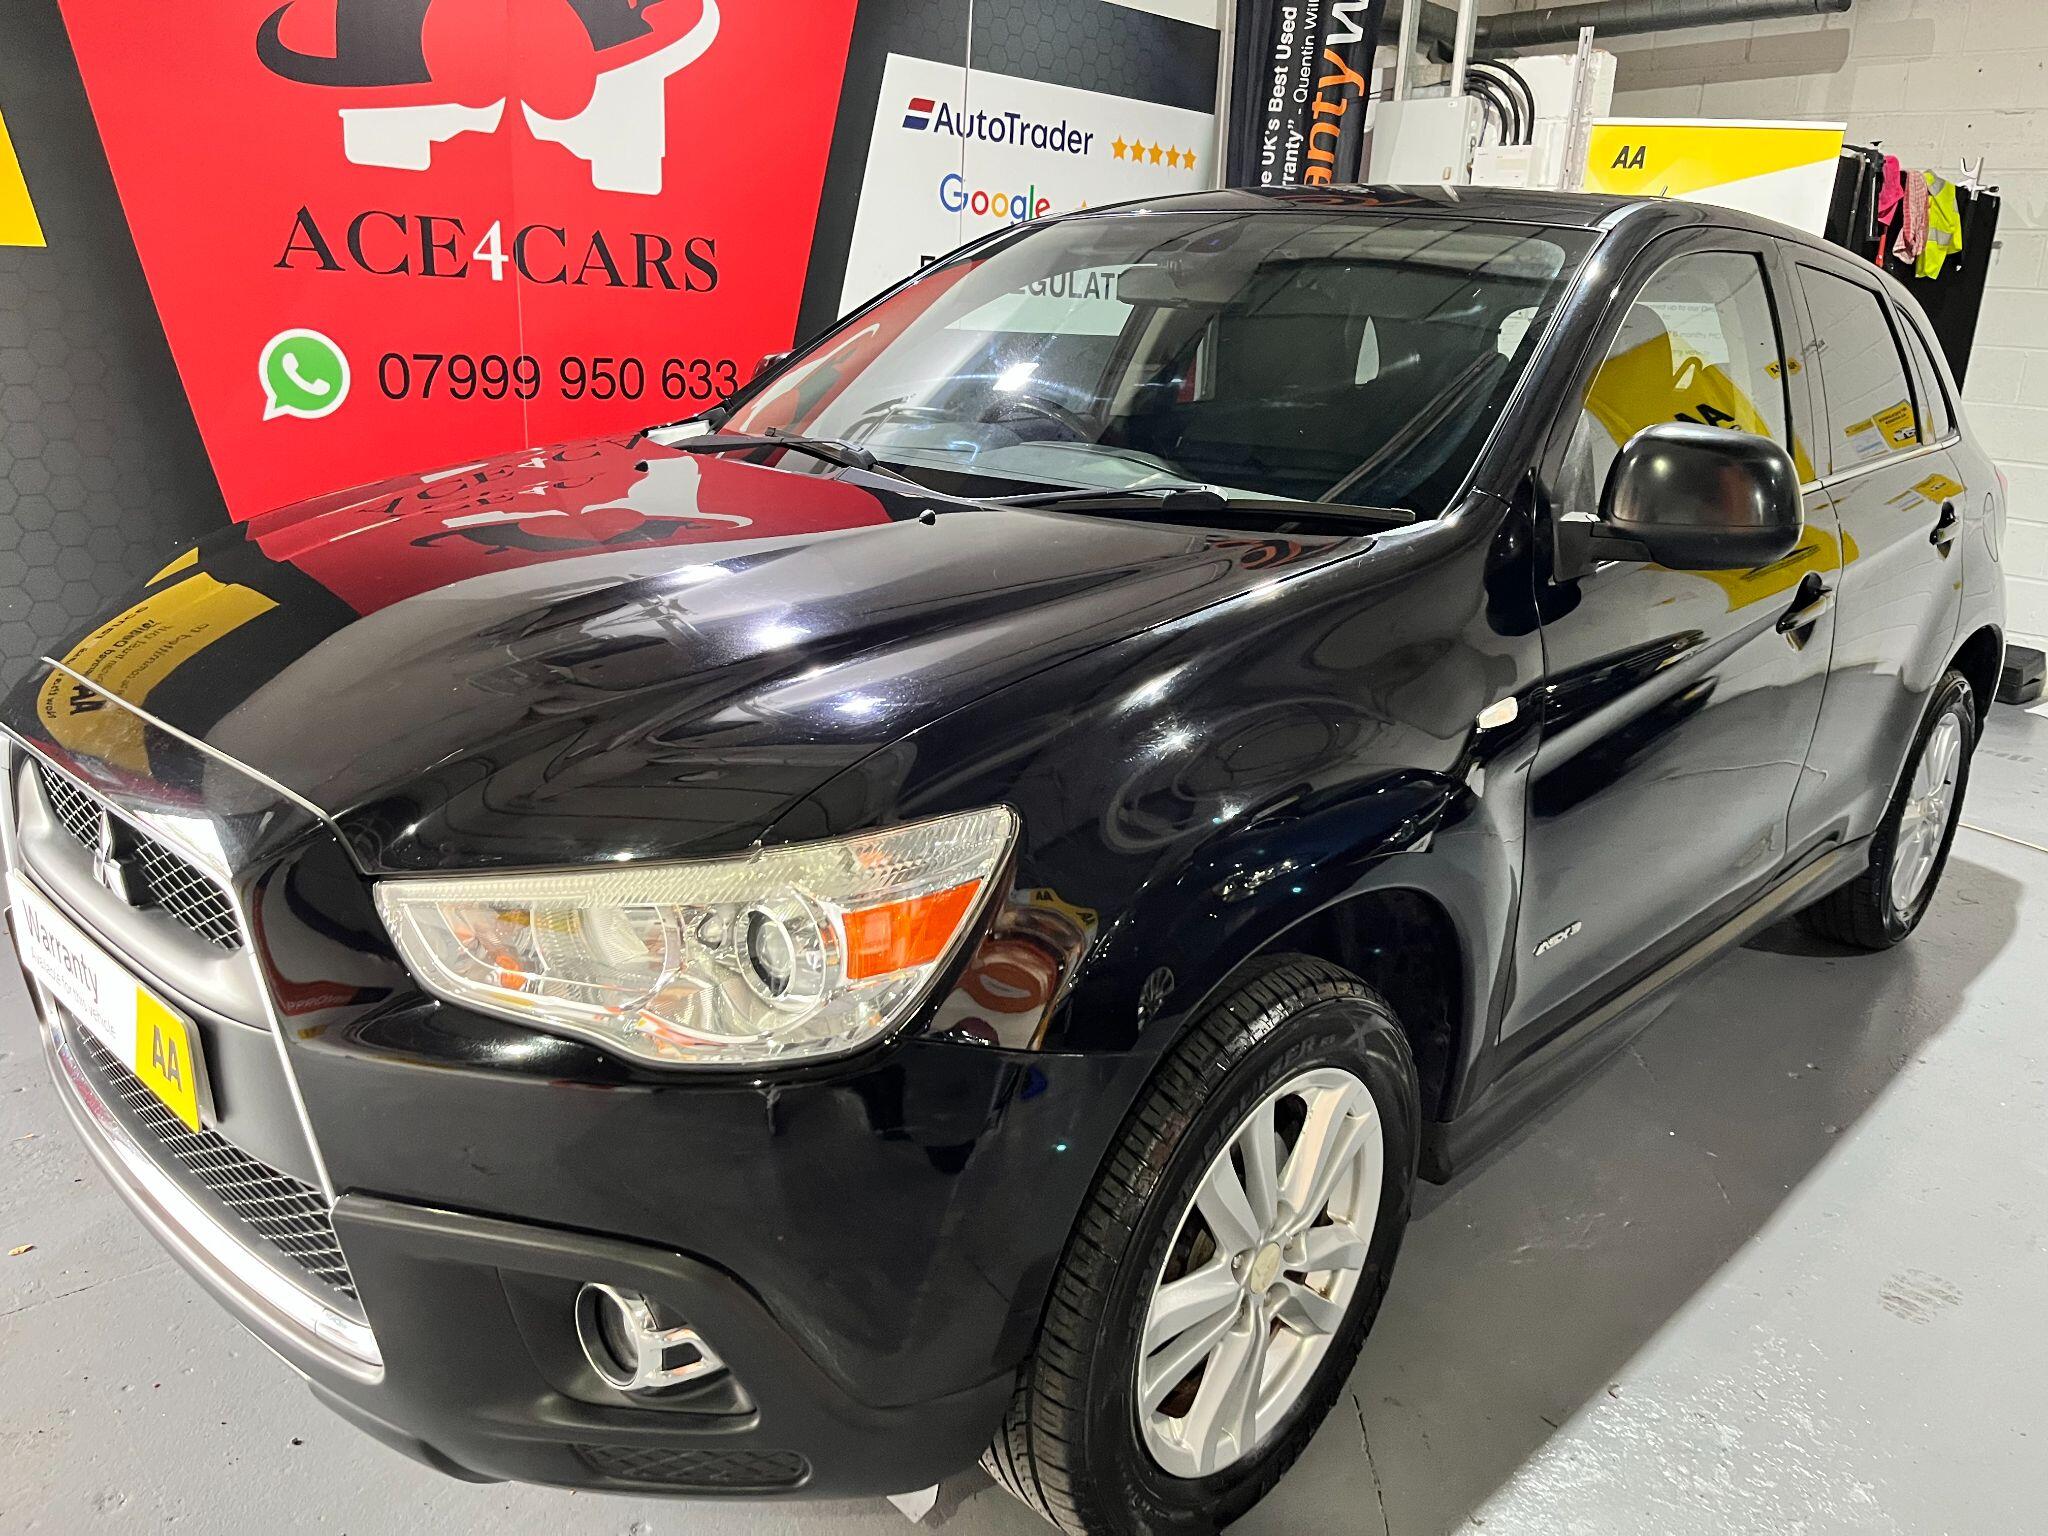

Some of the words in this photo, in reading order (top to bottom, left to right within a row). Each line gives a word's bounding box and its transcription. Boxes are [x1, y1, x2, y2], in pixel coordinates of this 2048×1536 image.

[1275, 7, 1297, 59] Used
[1268, 65, 1289, 112] Best
[1293, 35, 1315, 103] Quentin
[933, 102, 1094, 155] AutoTrader
[1261, 118, 1280, 165] UK's
[1610, 145, 1647, 169] AA
[939, 173, 1050, 223] Google
[274, 205, 719, 292] ACE4CARS
[378, 352, 541, 400] 07999
[559, 356, 645, 400] 950
[661, 358, 739, 400] 633
[22, 899, 98, 1005] Warranty
[152, 1024, 183, 1093] AA
